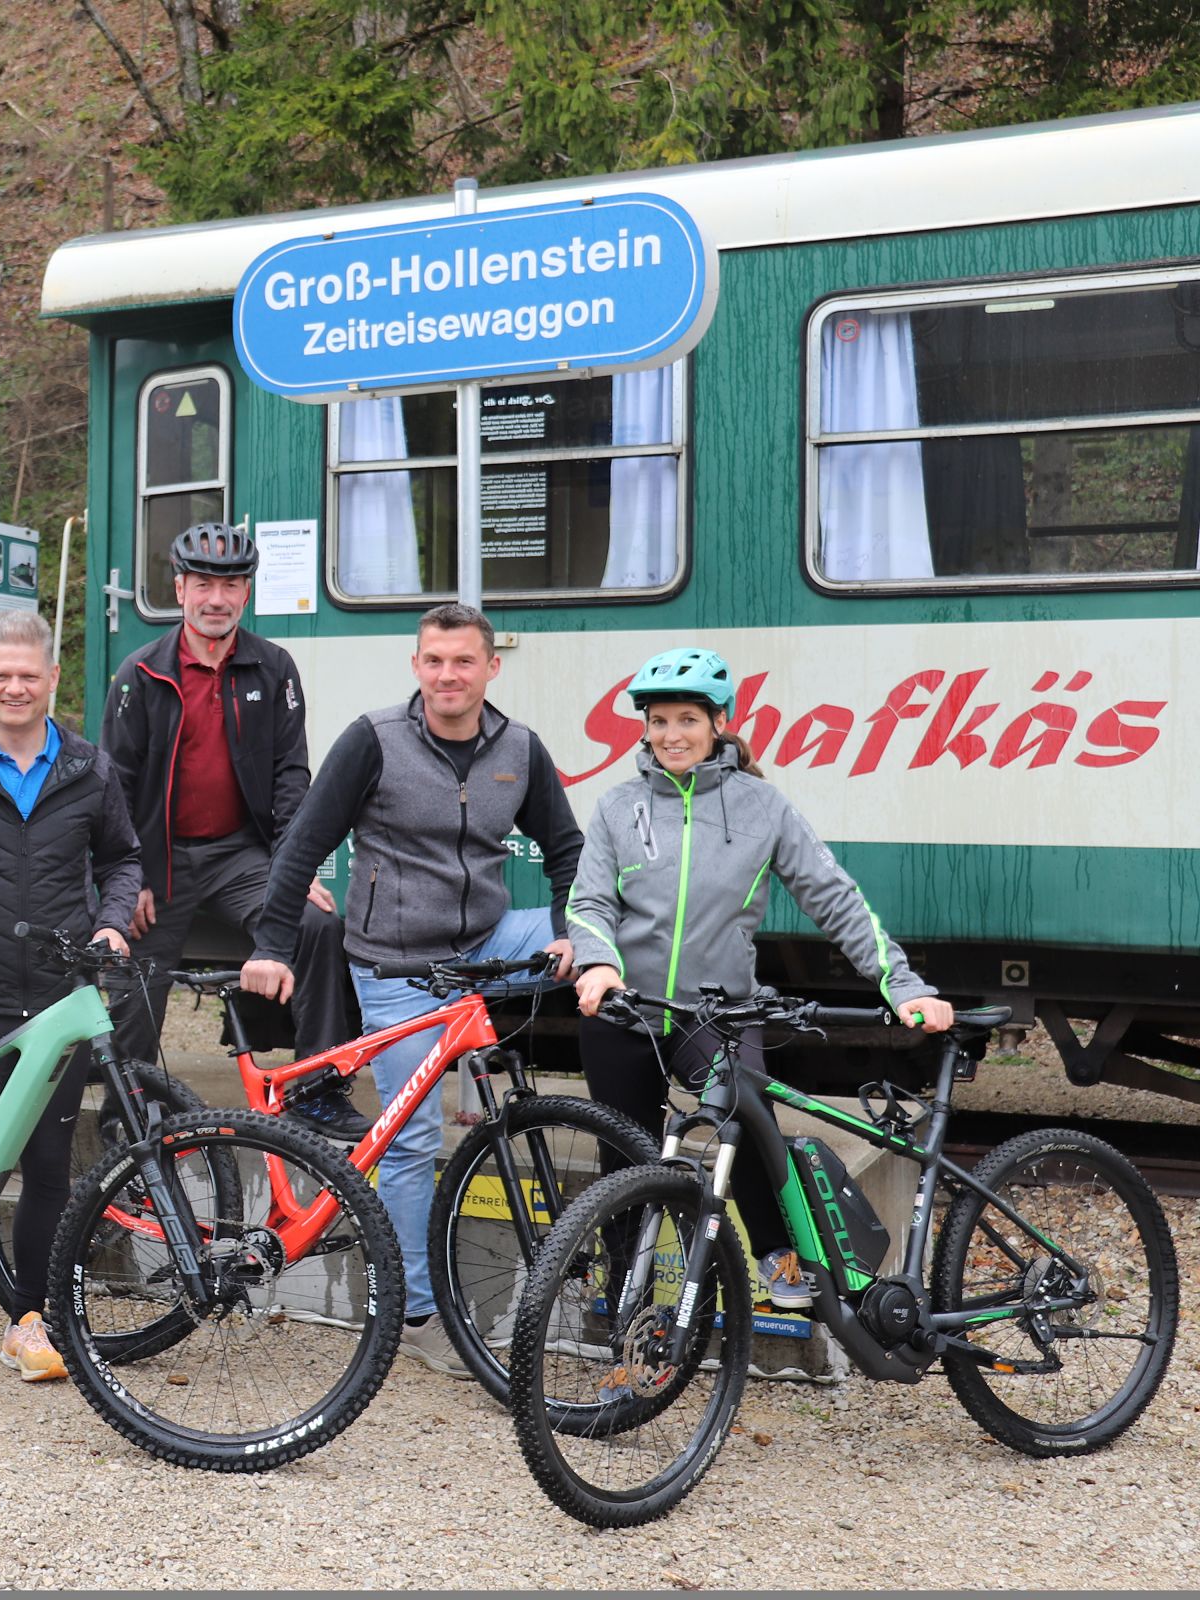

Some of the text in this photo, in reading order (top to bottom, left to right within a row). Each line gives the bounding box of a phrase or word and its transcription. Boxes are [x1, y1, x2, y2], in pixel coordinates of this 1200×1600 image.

[264, 228, 662, 311] Groß-Hollenstein
[302, 297, 615, 356] Zeitreisewaggon
[555, 668, 1169, 788] Shafkäs
[72, 1263, 85, 1316] DT SWISS
[366, 1263, 377, 1317] DT SWISS
[675, 1280, 699, 1329] ROCKSHOX
[244, 1414, 324, 1455] MAXXIS
